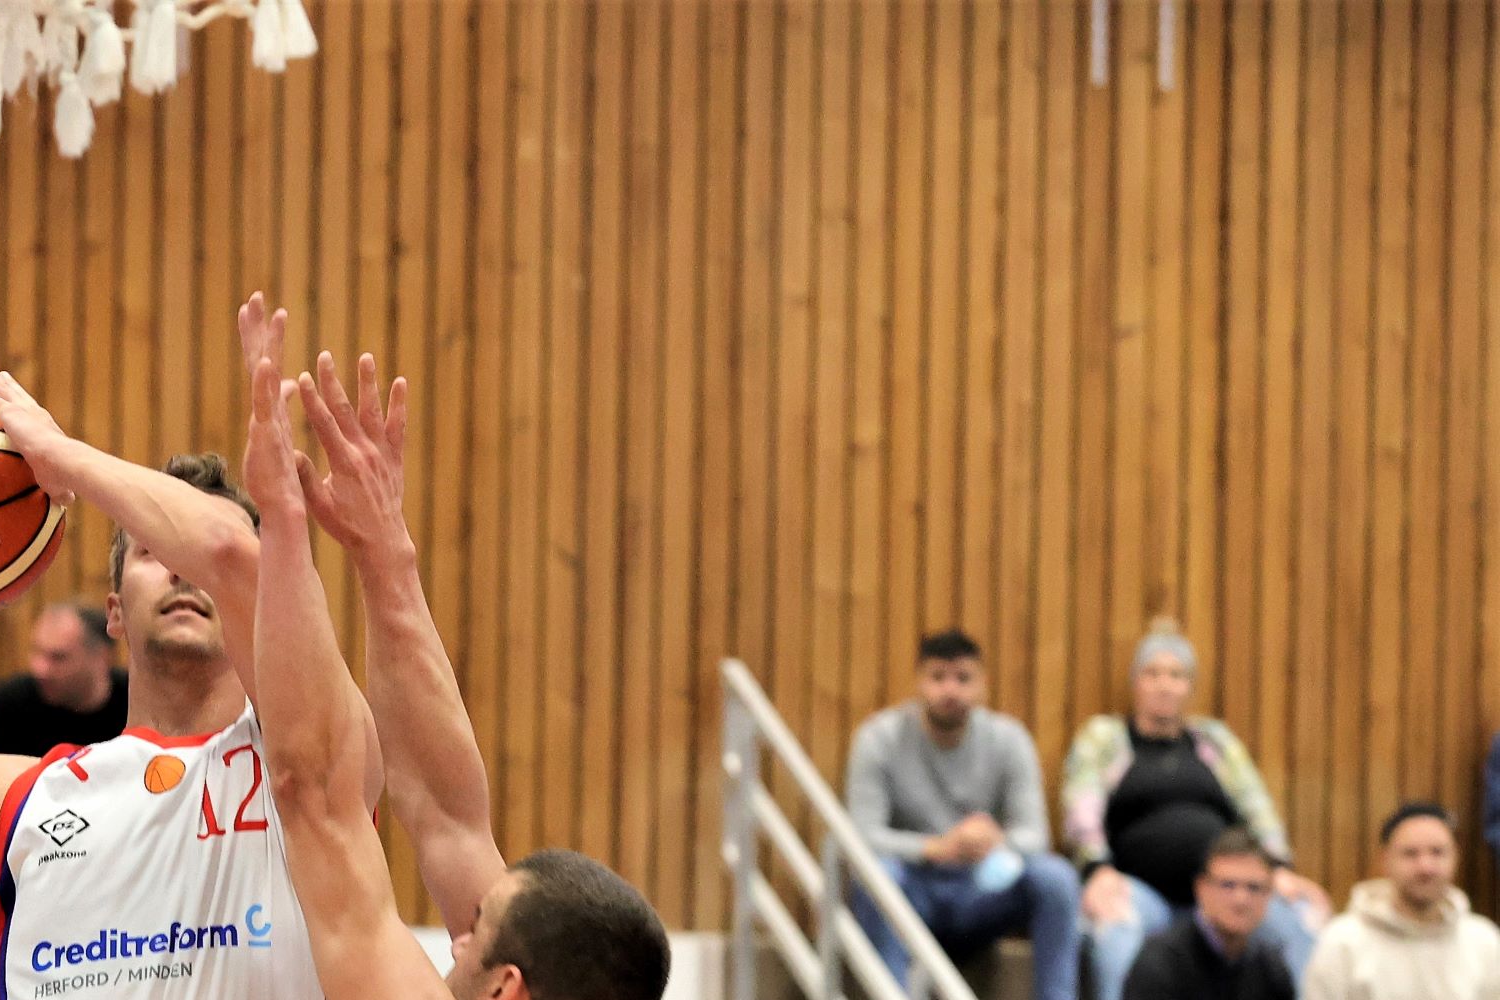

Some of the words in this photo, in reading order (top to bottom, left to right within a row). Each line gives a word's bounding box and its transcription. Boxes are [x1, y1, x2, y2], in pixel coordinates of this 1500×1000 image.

[197, 744, 269, 840] 12
[37, 849, 88, 867] peakzone
[31, 922, 239, 973] Creditreform
[34, 971, 110, 1000] HERFORD
[128, 961, 194, 982] MINDEN
